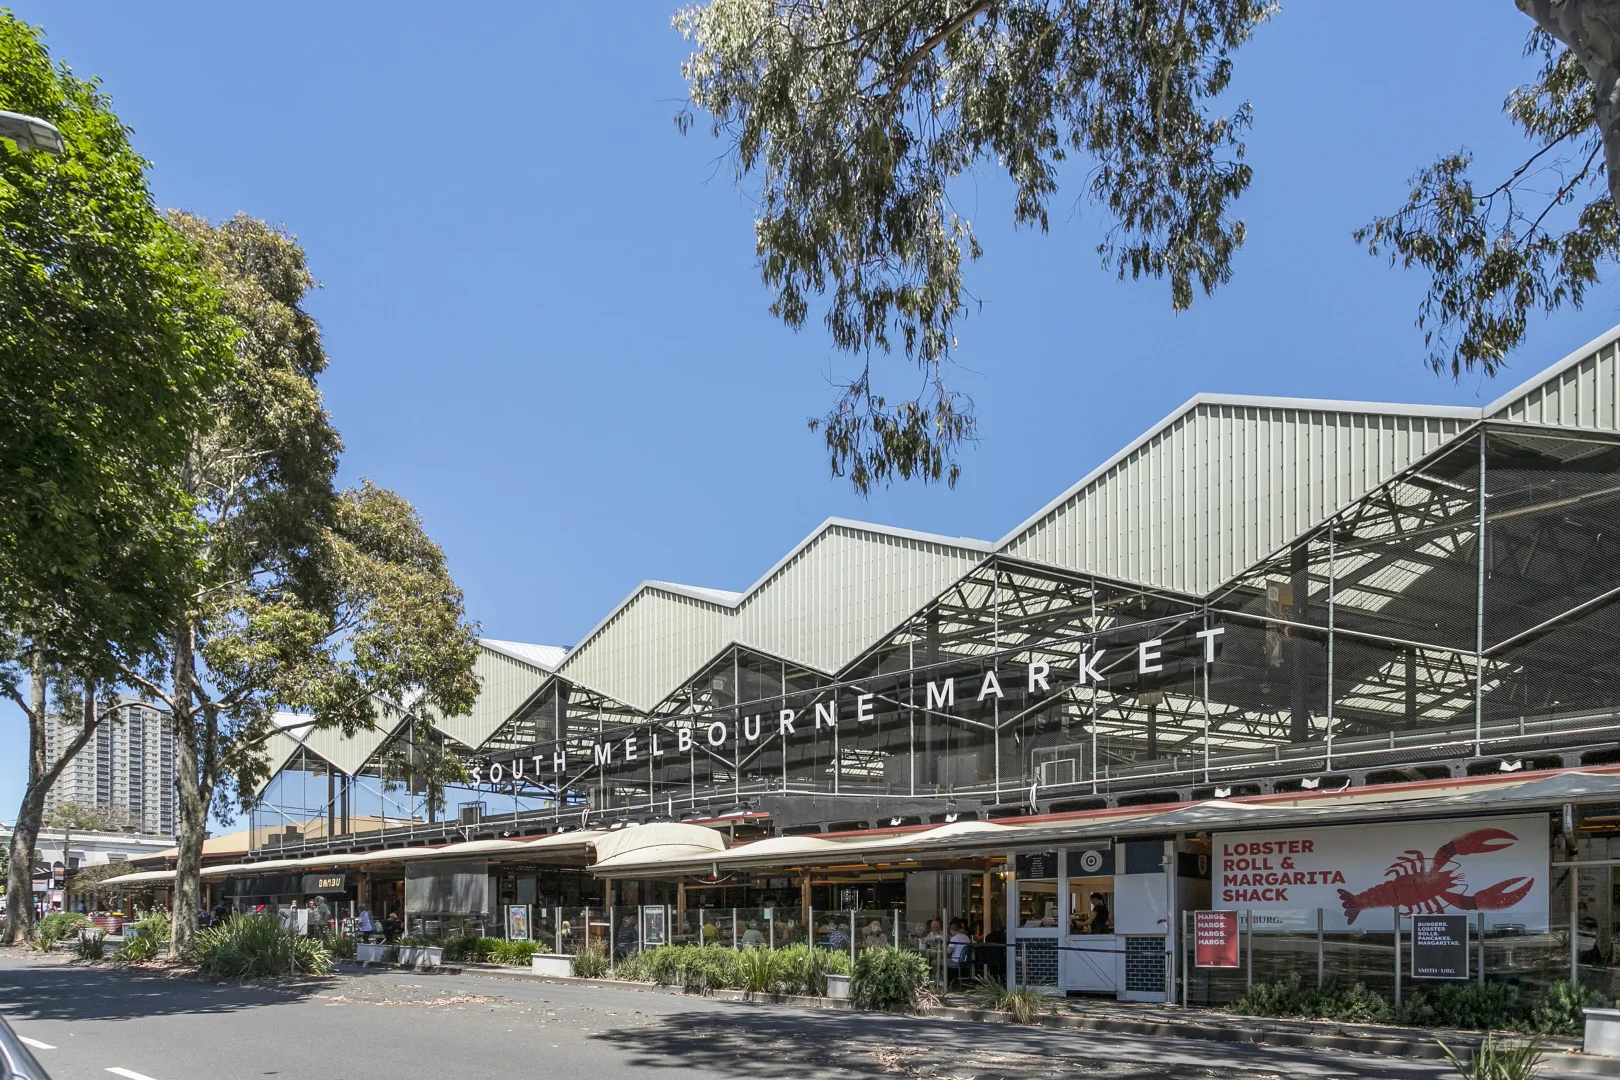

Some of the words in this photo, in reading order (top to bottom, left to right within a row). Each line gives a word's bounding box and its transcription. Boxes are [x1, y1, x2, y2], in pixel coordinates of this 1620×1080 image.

[472, 750, 566, 787] SOUTH
[593, 693, 874, 766] MELBOURNE
[926, 627, 1225, 709] MARKET
[1223, 840, 1314, 857] LOBSTER
[1223, 858, 1273, 871] ROLL
[1280, 856, 1295, 869] &
[318, 877, 341, 888] BAMBU
[1223, 870, 1346, 887] MARGARITA
[1222, 888, 1289, 902] SHACK
